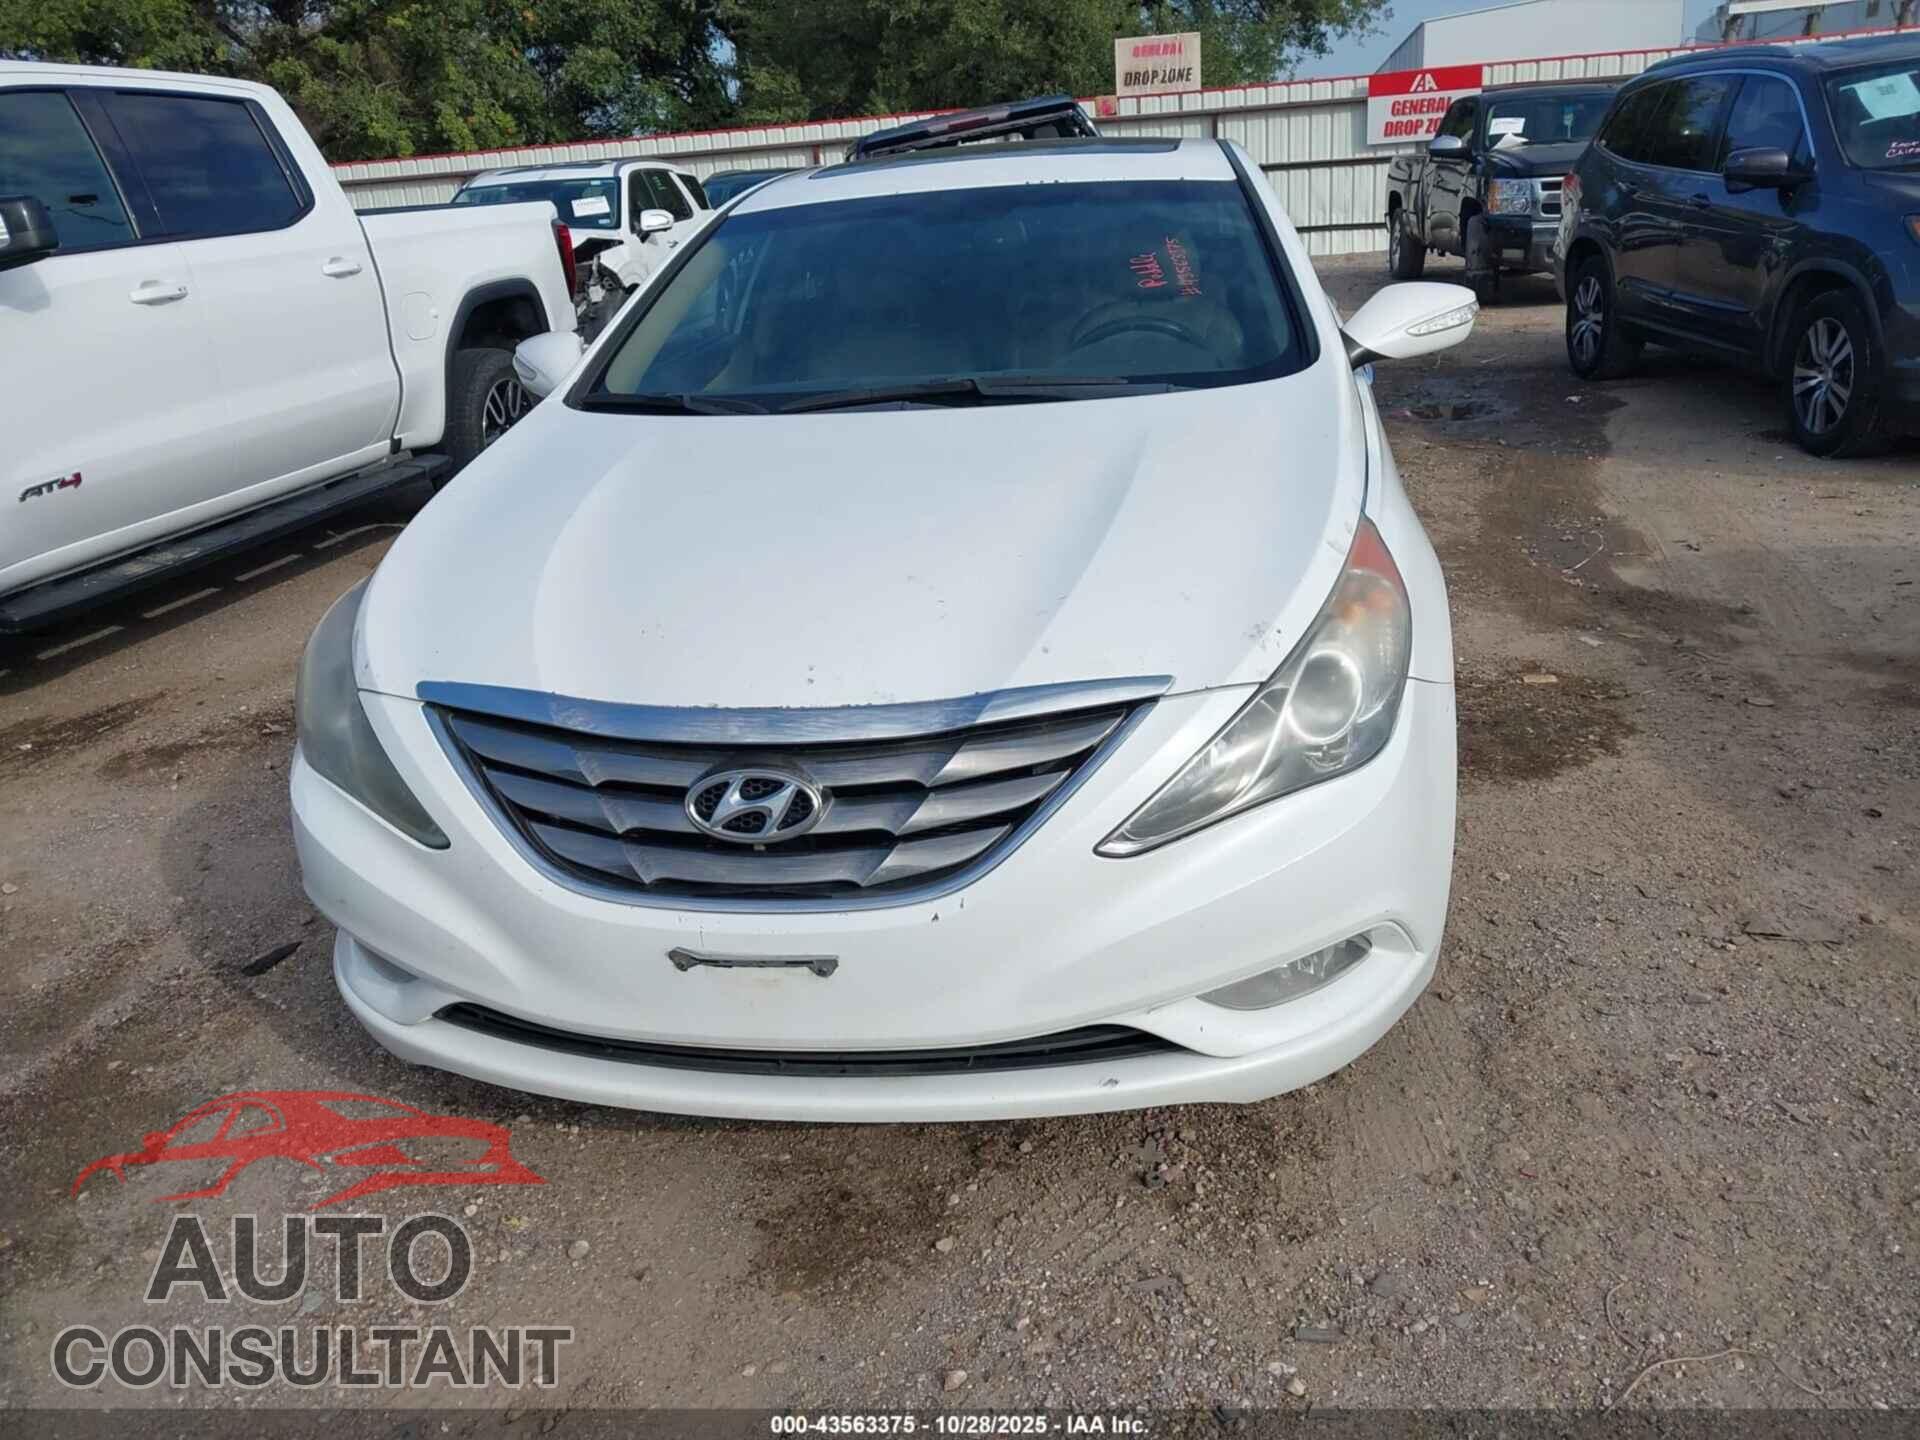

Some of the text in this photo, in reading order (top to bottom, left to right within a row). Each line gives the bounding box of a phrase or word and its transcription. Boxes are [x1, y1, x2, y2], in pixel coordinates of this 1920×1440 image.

[1124, 66, 1193, 87] DROP ZONE
[1383, 117, 1442, 138] DROP ZO
[19, 471, 82, 502] AT4
